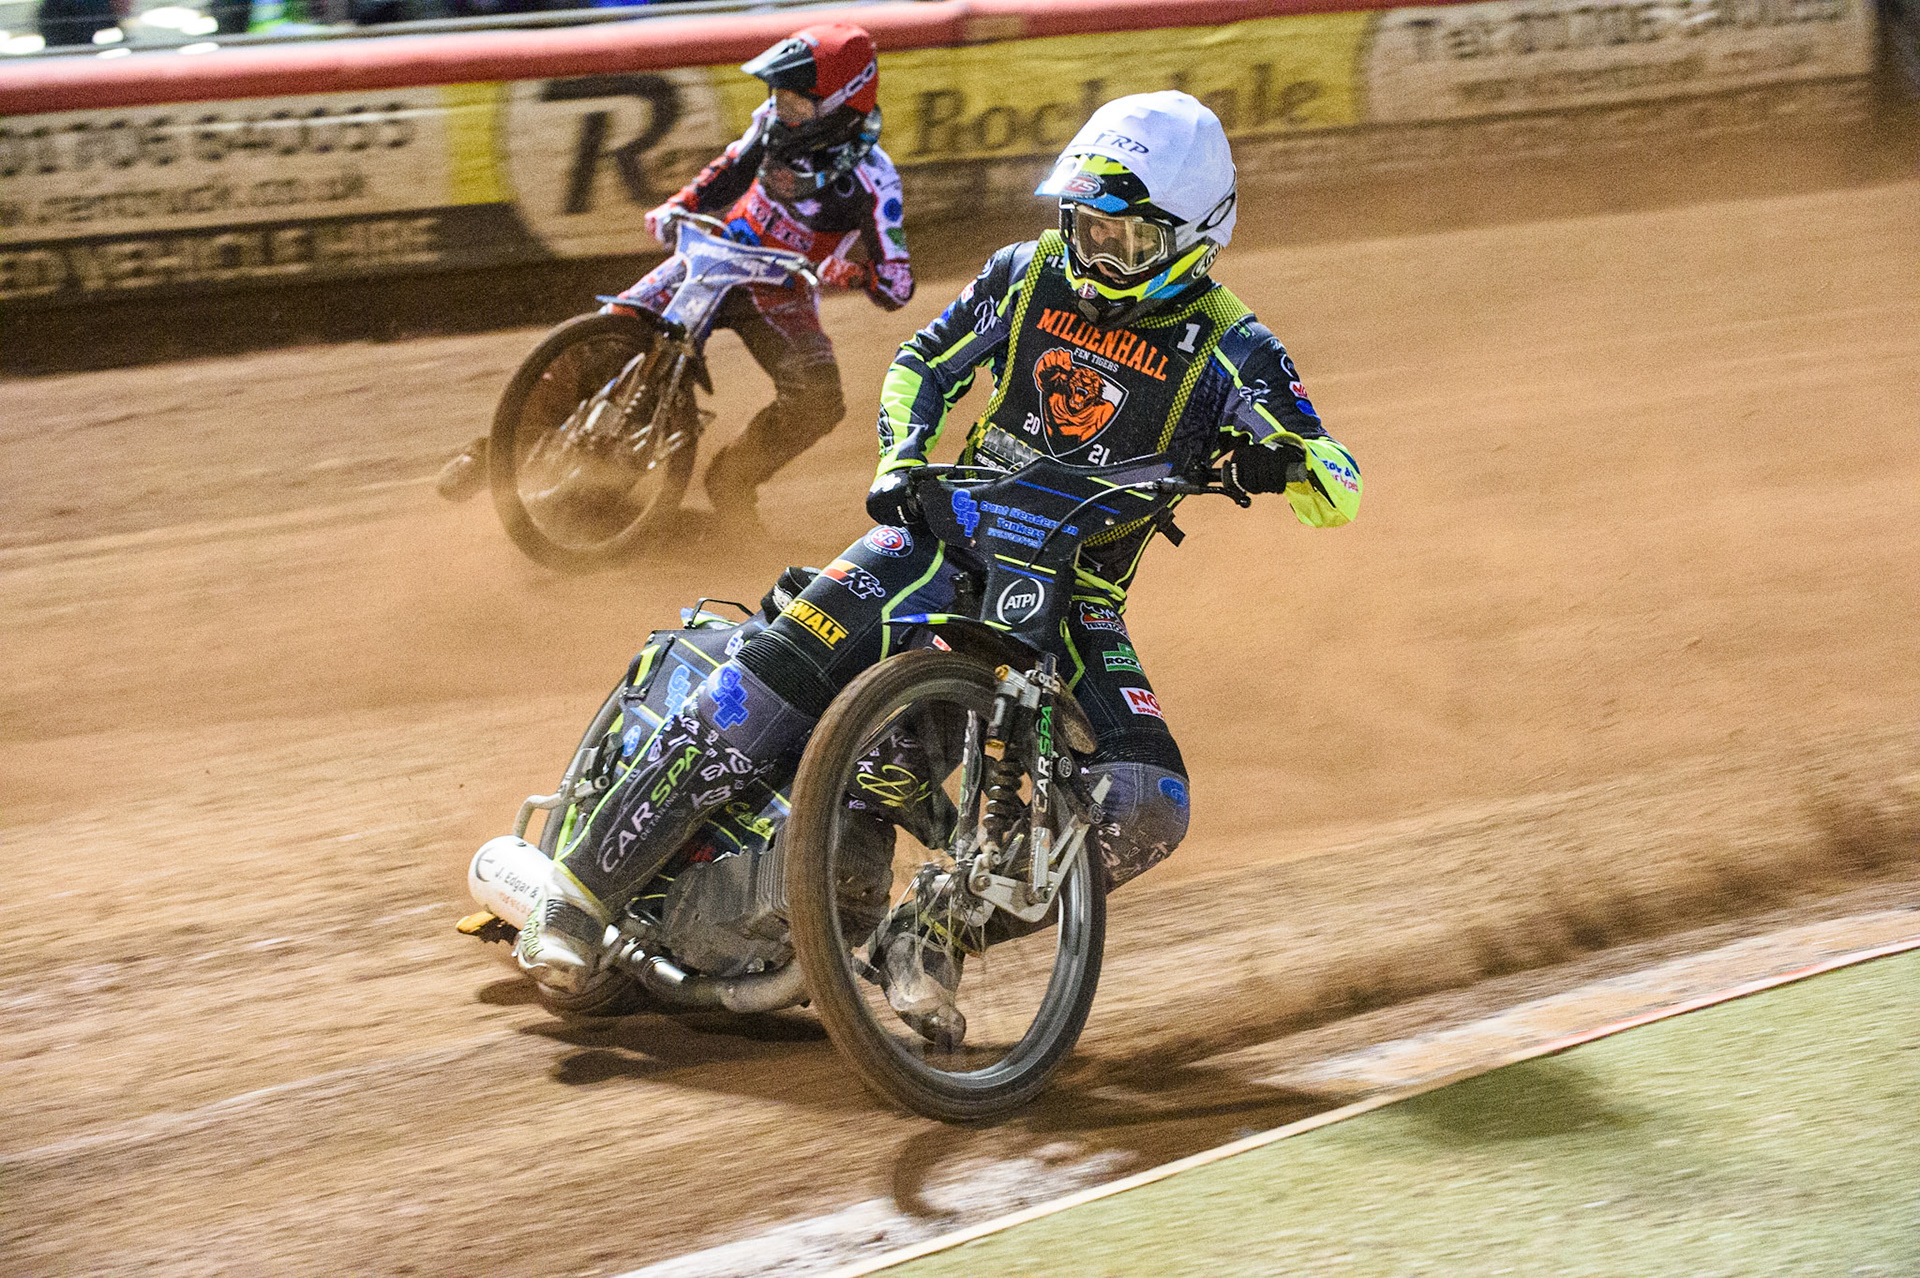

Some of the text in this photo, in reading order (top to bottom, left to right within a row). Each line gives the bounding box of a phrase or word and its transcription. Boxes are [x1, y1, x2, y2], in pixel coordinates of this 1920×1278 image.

[1036, 308, 1170, 382] MILDENHALL
[1177, 322, 1201, 354] 1
[1073, 346, 1121, 374] FEN TIGERS
[1023, 411, 1111, 467] 20 21
[1003, 592, 1037, 611] ATPI
[504, 871, 531, 895] Edgar
